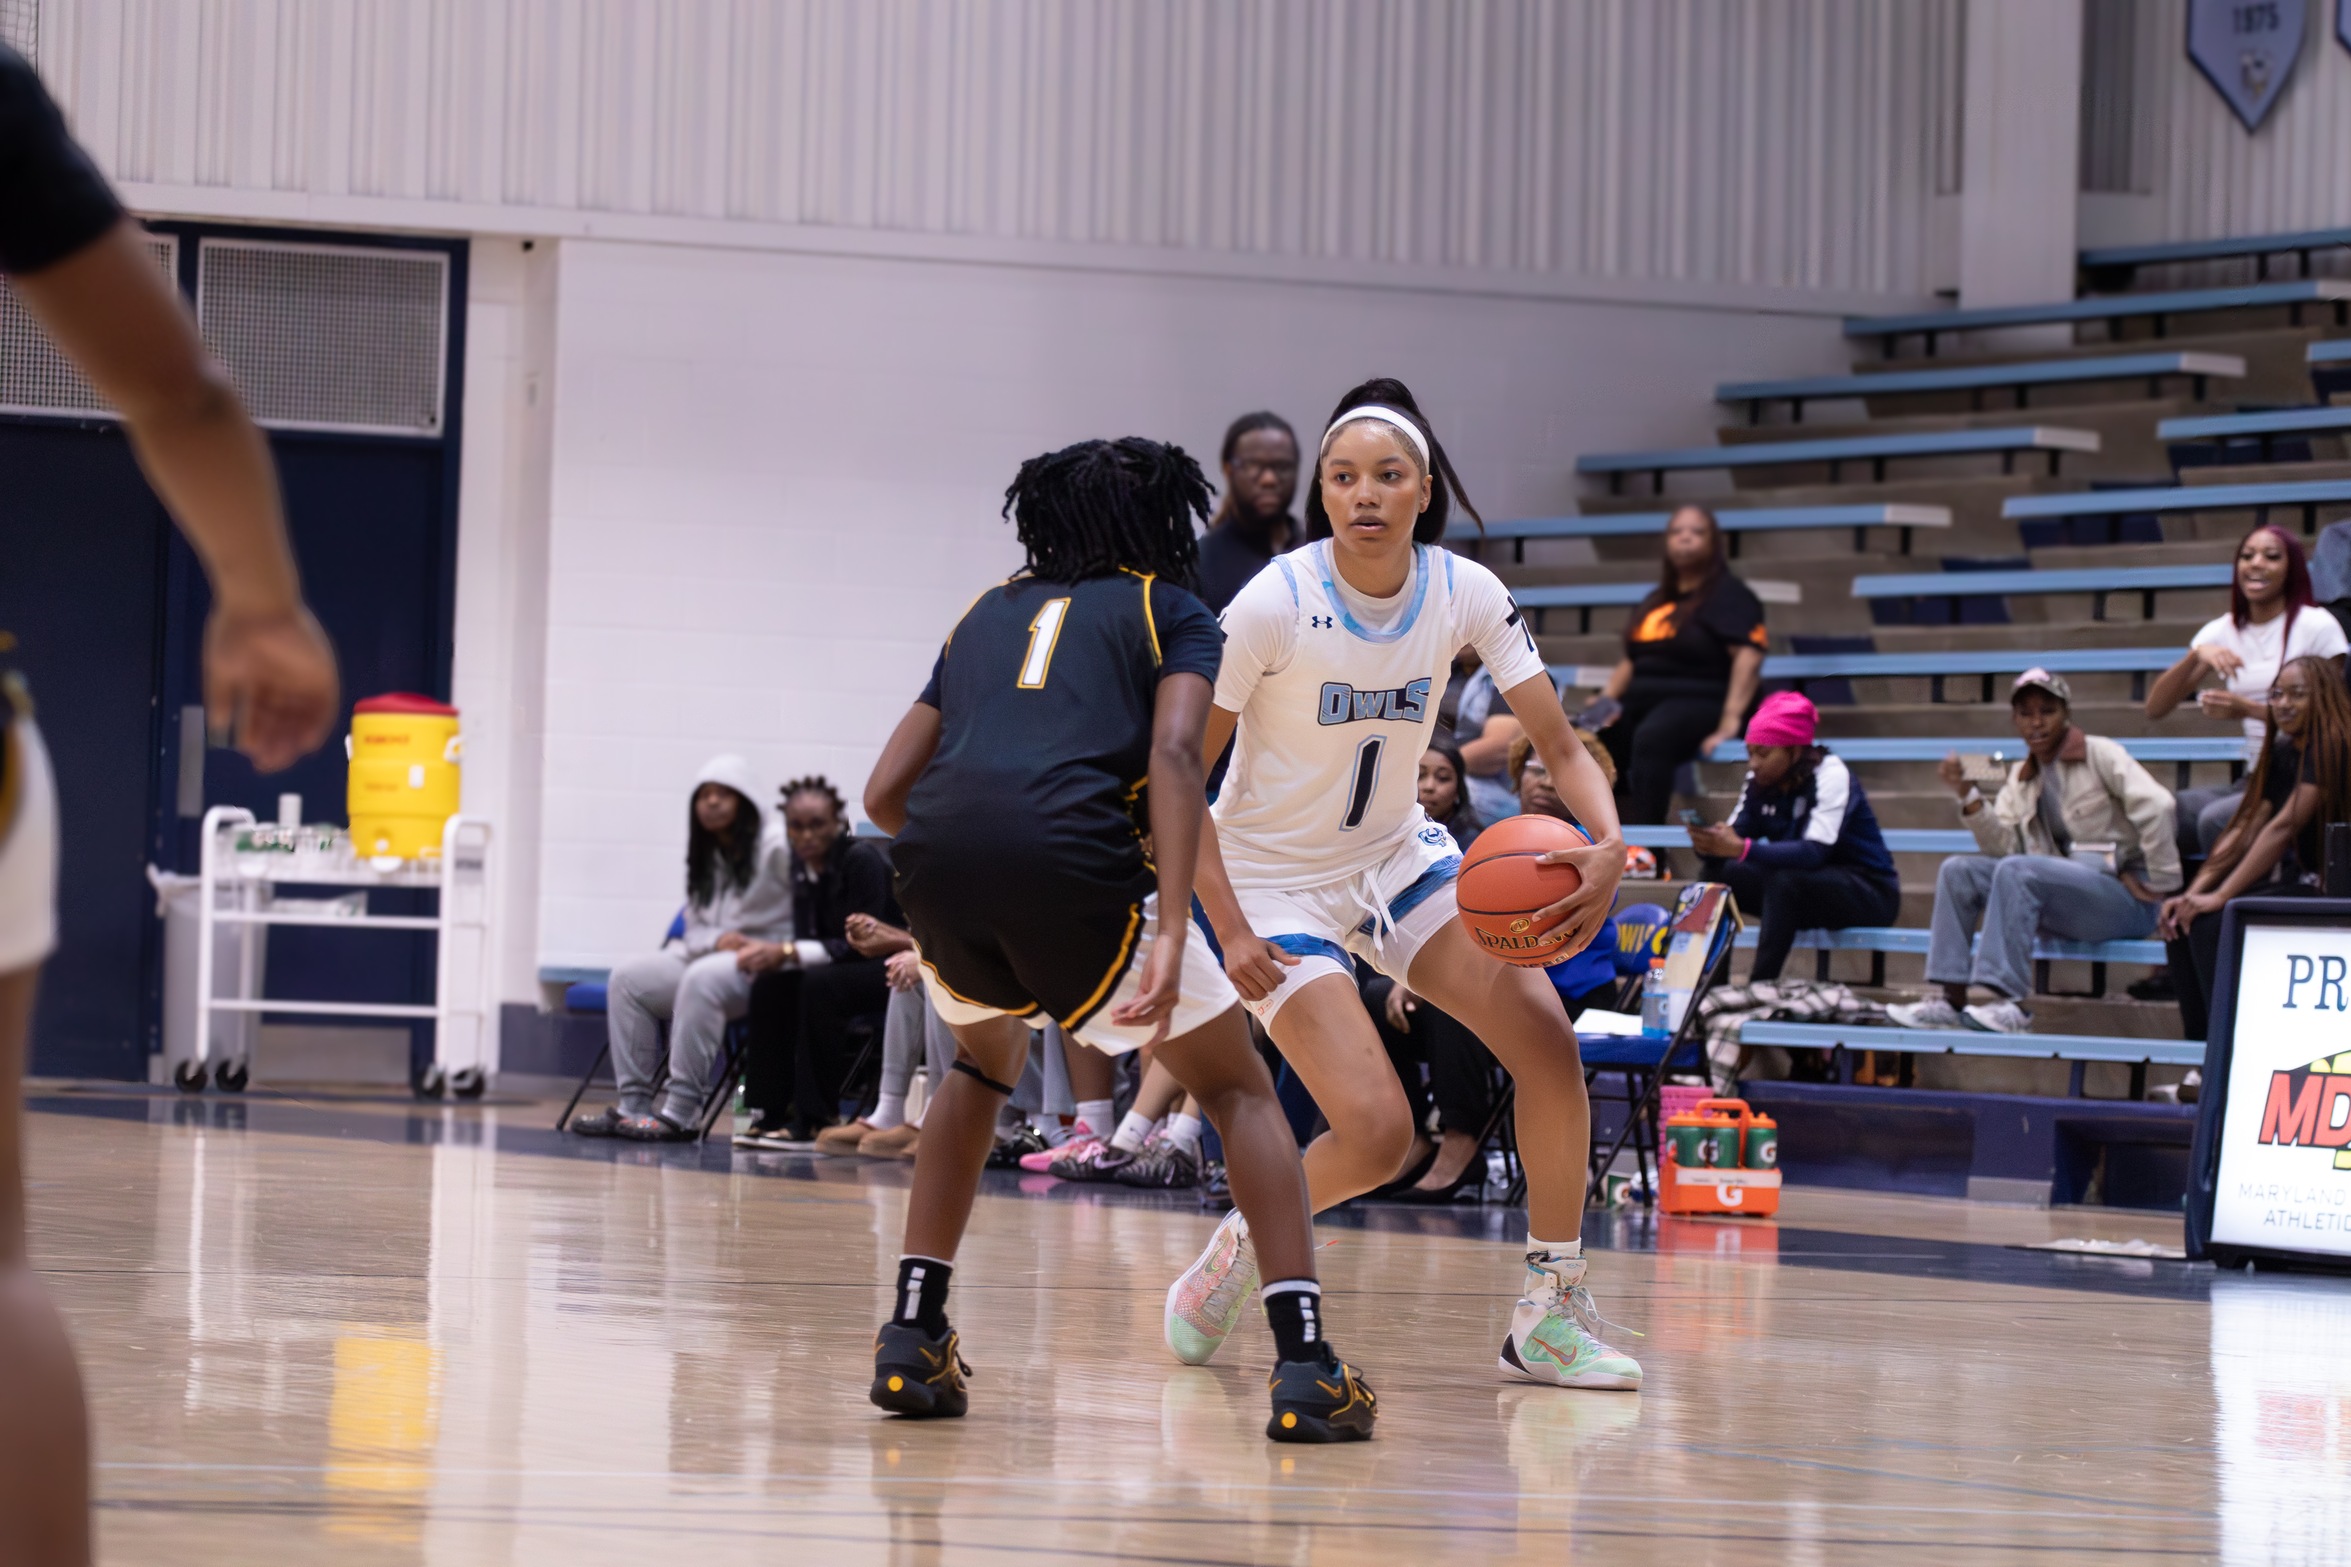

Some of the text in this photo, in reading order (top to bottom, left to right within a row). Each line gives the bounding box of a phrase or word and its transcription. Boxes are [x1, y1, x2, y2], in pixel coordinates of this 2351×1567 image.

[1016, 597, 1072, 689] 1
[1318, 677, 1432, 726] OWLS
[1338, 734, 1388, 832] 1
[2282, 954, 2349, 1012] PR
[1717, 1183, 1743, 1207] G
[2239, 1183, 2346, 1206] MARYLAND
